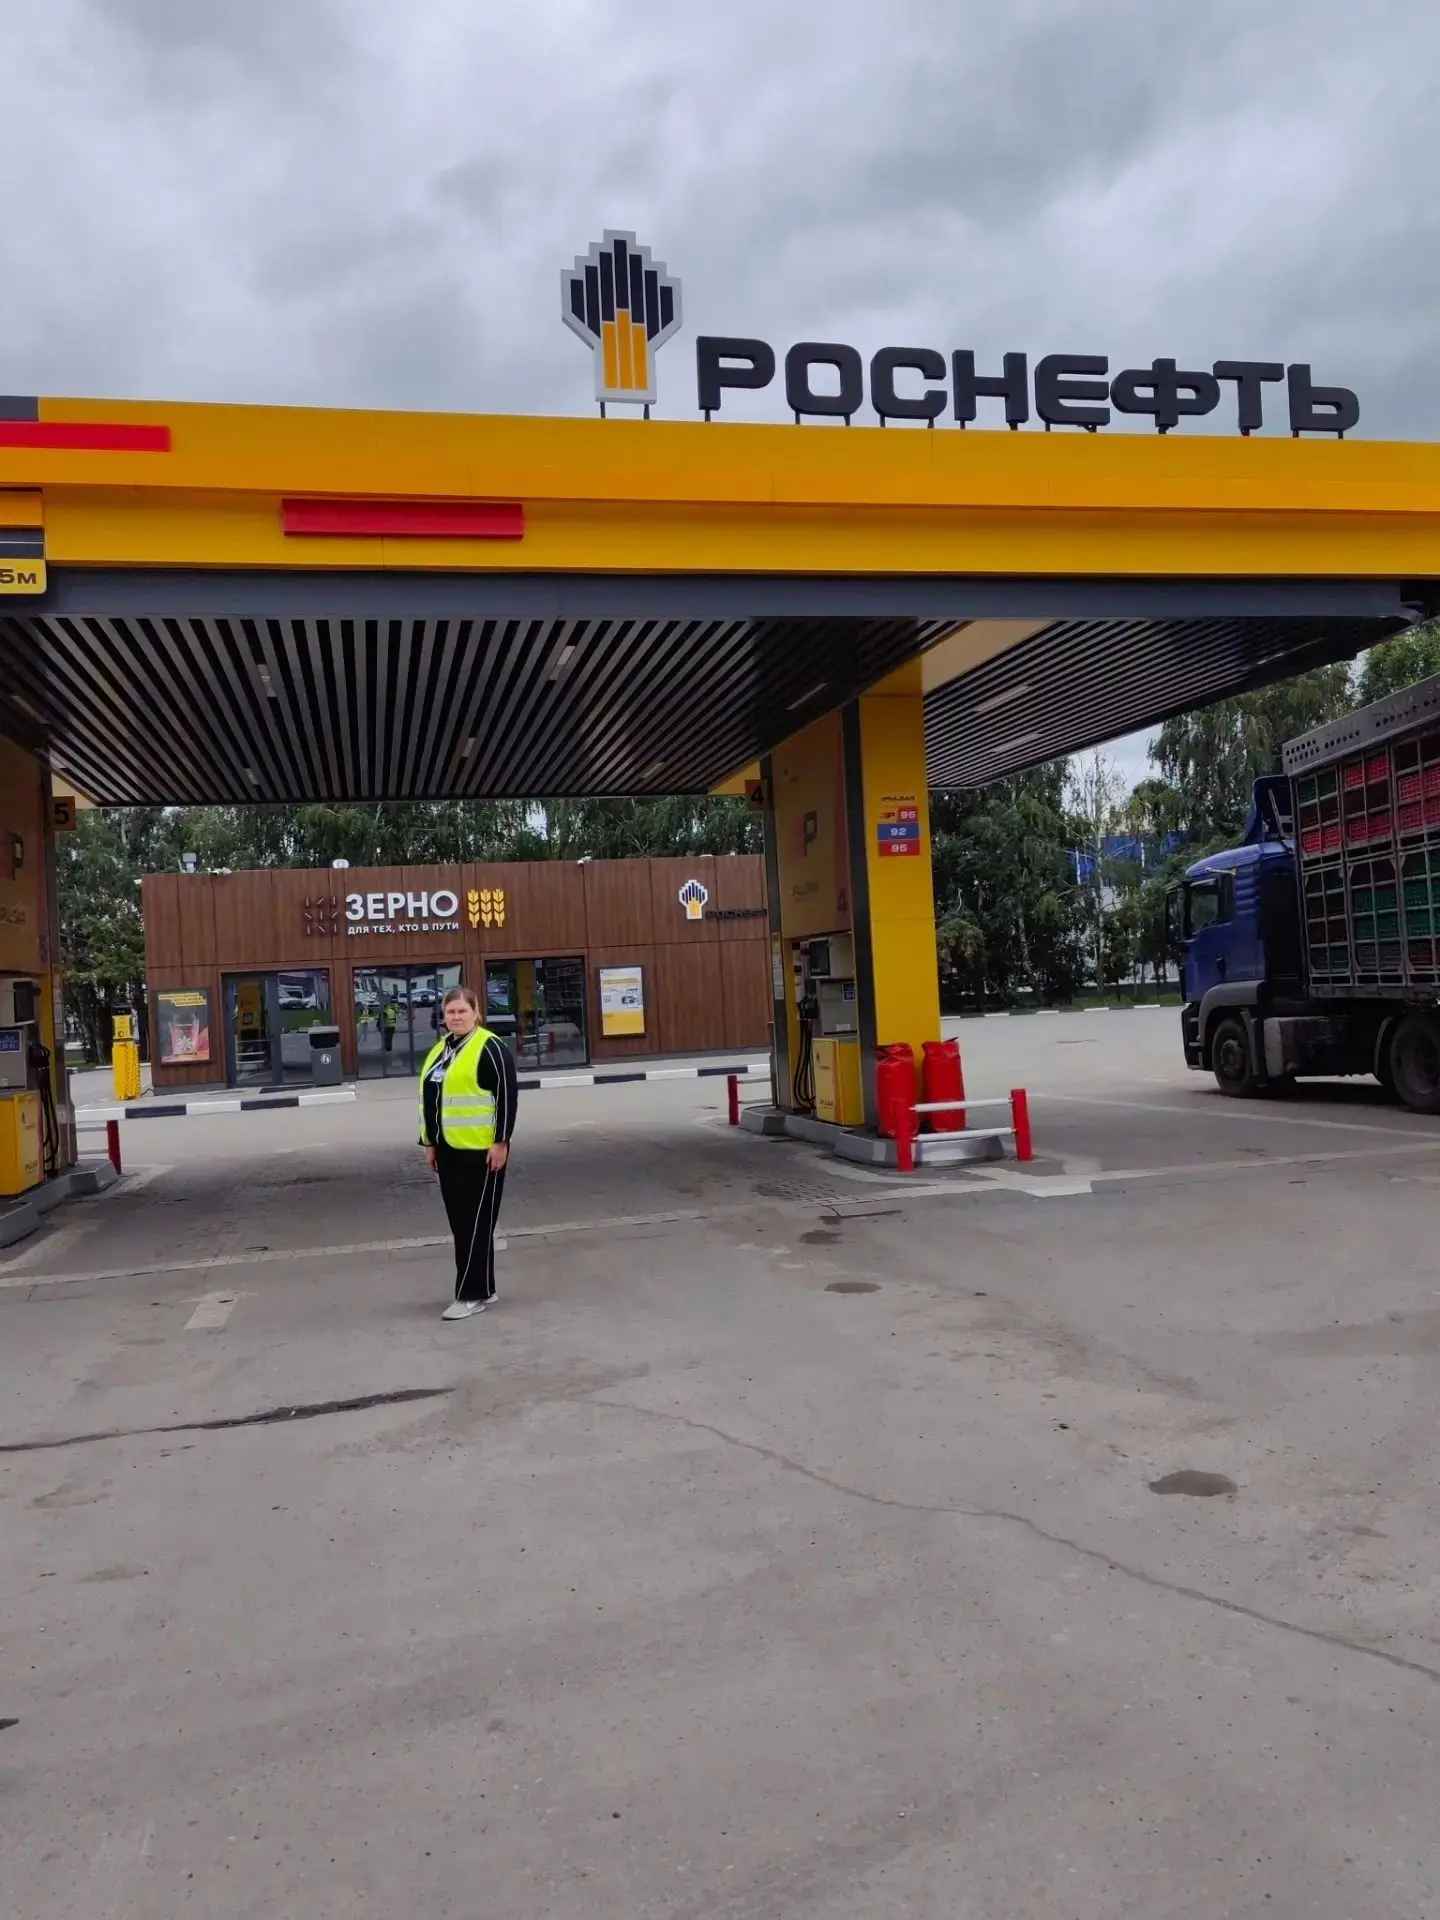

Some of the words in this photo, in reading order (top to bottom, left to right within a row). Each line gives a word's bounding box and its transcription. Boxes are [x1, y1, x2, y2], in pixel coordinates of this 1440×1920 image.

[697, 336, 1359, 432] РОСНЕФТЬ
[751, 786, 764, 803] 4
[54, 803, 70, 824] 5
[890, 827, 907, 836] 92
[345, 890, 459, 920] ЗЕРНО
[347, 926, 370, 935] ДЛЯ
[373, 924, 396, 933] ТЕХ,
[399, 923, 419, 932] КТО
[422, 923, 429, 931] В
[432, 922, 459, 931] ПУТИ
